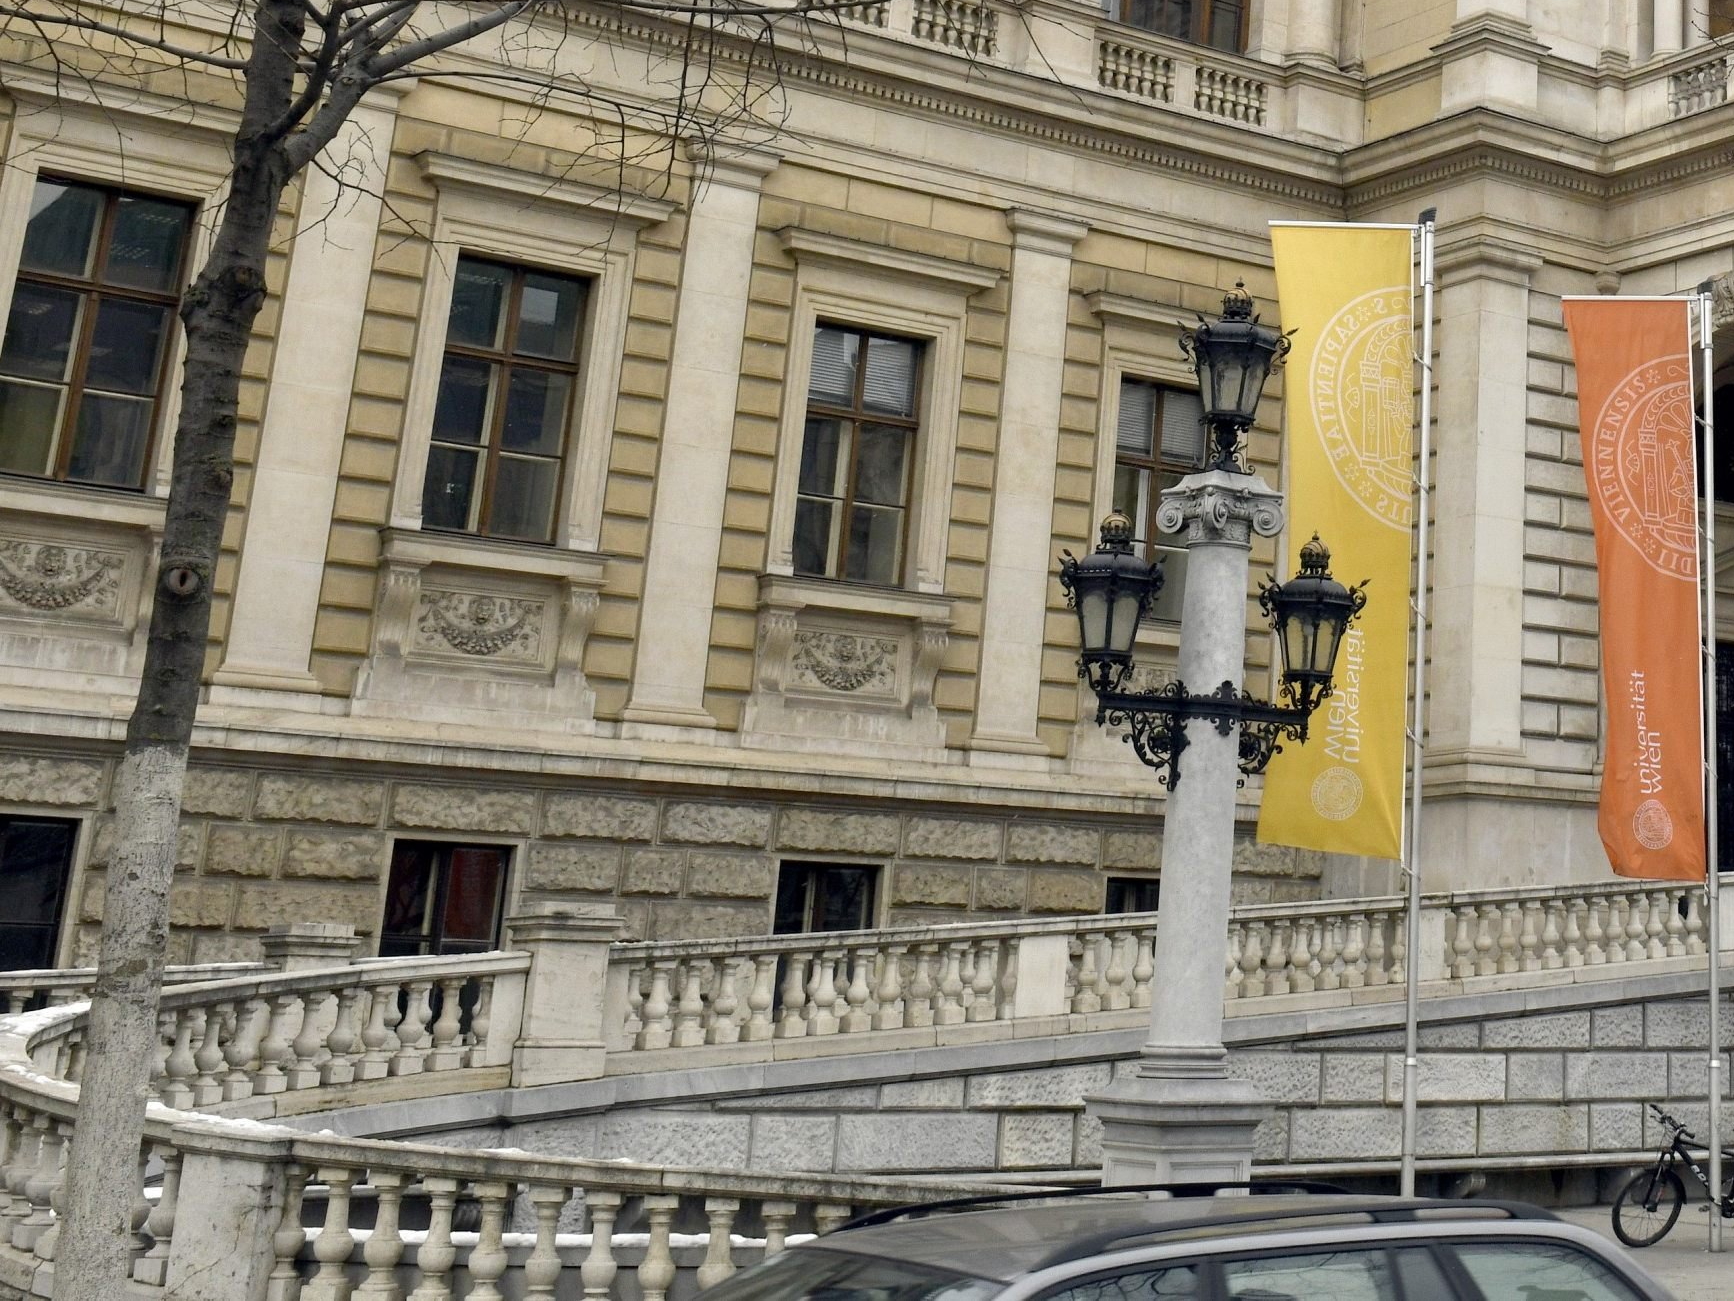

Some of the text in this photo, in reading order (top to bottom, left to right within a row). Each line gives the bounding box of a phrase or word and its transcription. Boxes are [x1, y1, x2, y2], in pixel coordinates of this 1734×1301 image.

[1598, 375, 1646, 524] VIENNENSIS
[1630, 668, 1652, 794] universität
[1647, 731, 1663, 793] wien
